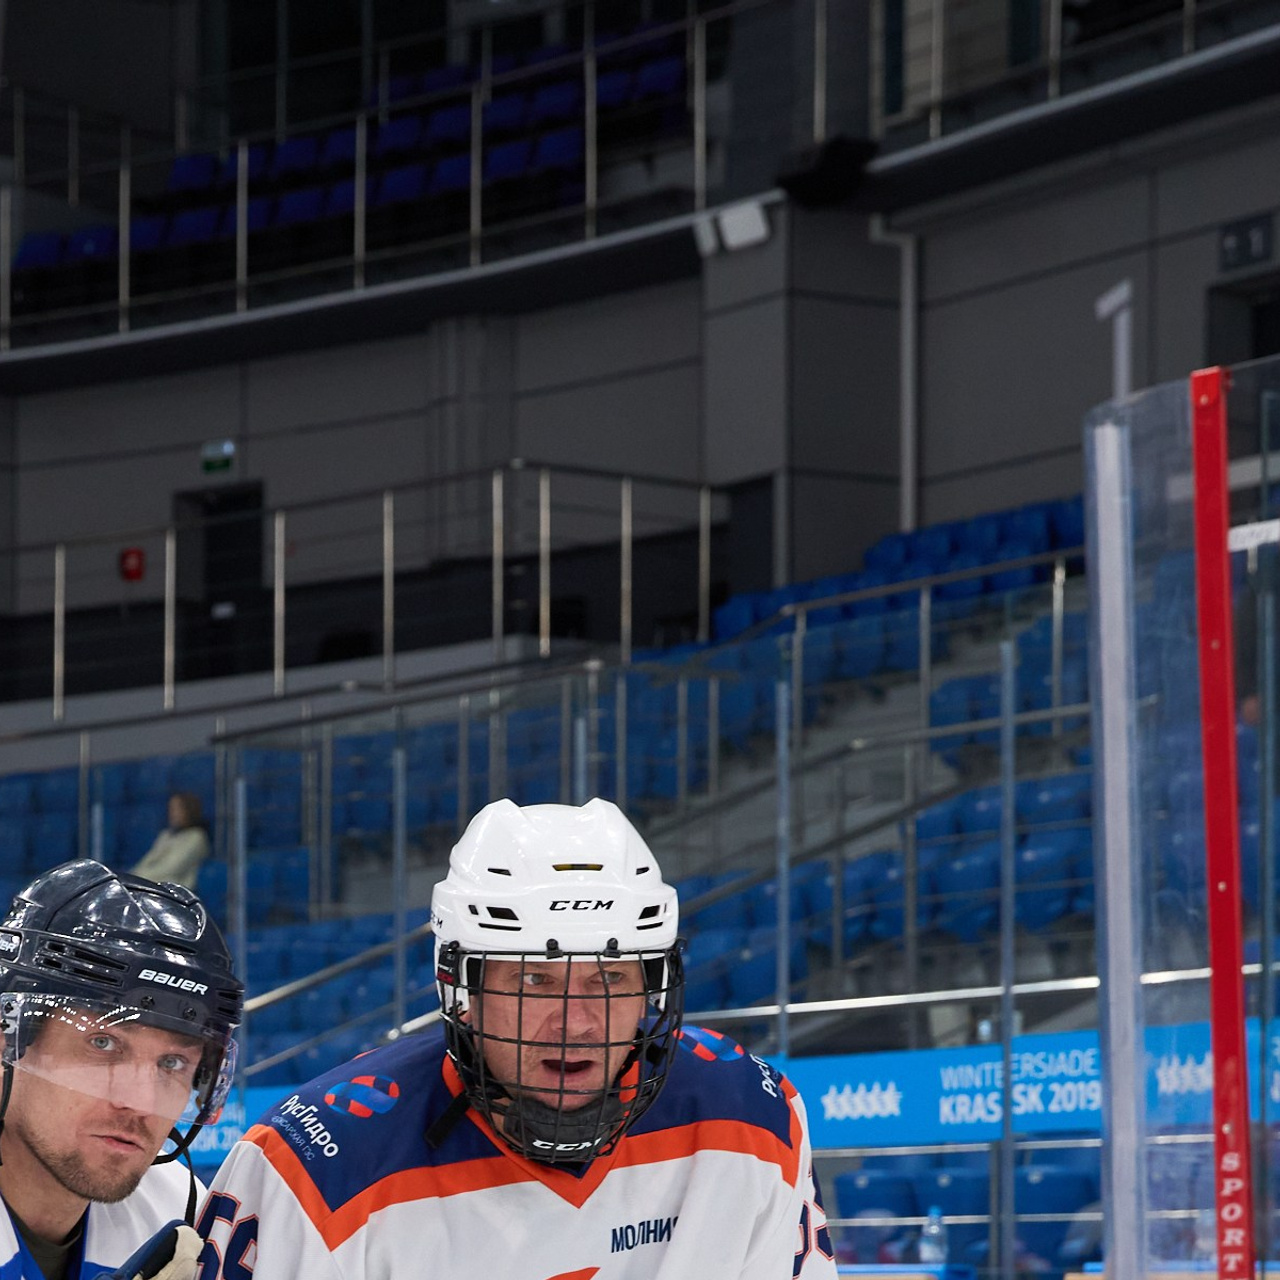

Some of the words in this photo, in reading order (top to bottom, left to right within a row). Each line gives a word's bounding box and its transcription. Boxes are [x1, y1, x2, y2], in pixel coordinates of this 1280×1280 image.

[549, 899, 614, 911] CCM
[138, 968, 209, 996] BAUER
[1048, 1079, 1102, 1114] 2019
[280, 1094, 339, 1158] РусГидро
[532, 1137, 602, 1151] CCM
